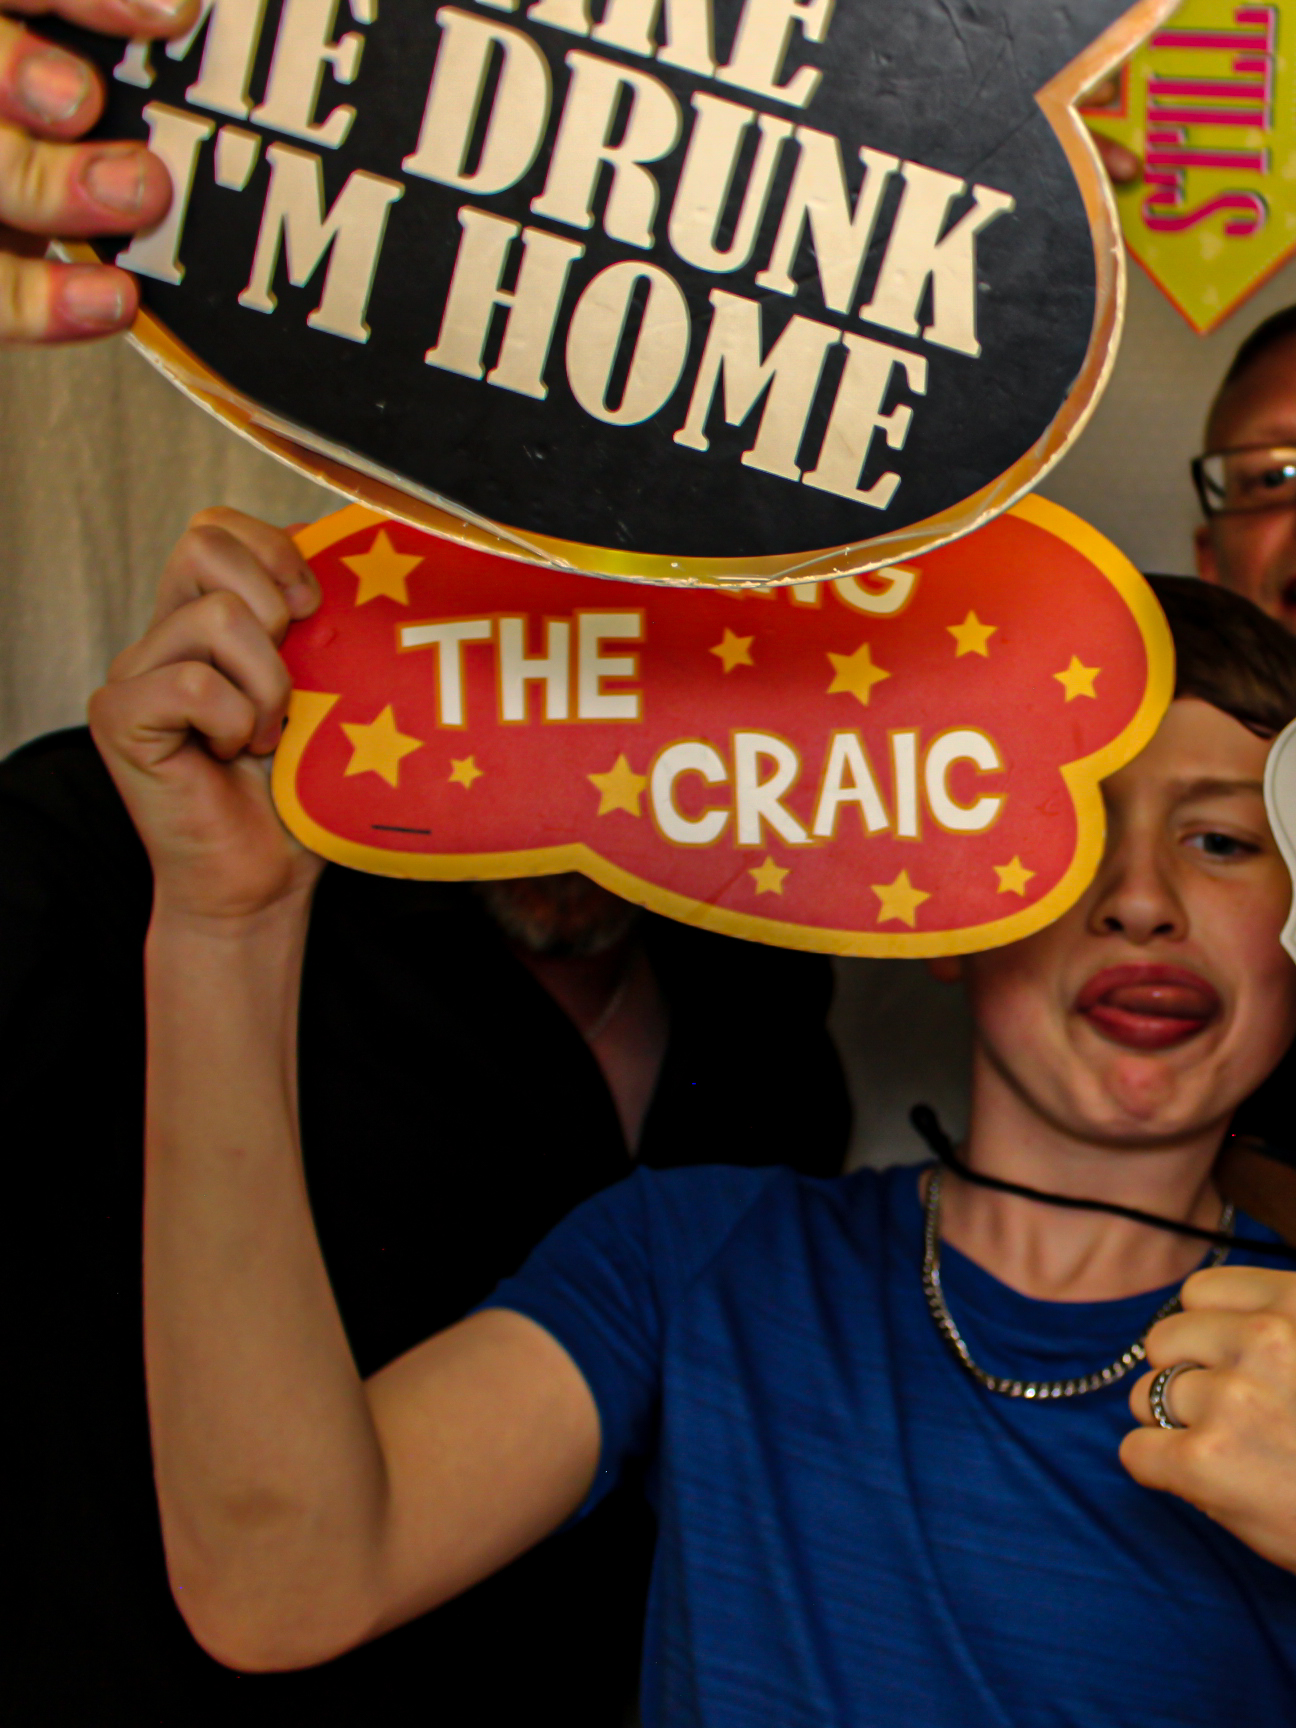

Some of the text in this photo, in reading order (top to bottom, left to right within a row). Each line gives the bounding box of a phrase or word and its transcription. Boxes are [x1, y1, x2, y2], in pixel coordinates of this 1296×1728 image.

[402, 5, 1015, 359] DRUNK
[1142, 5, 1278, 239] STILL
[115, 101, 928, 511] I'M HOME
[400, 611, 642, 726] THE
[650, 729, 1002, 846] CRAIC
